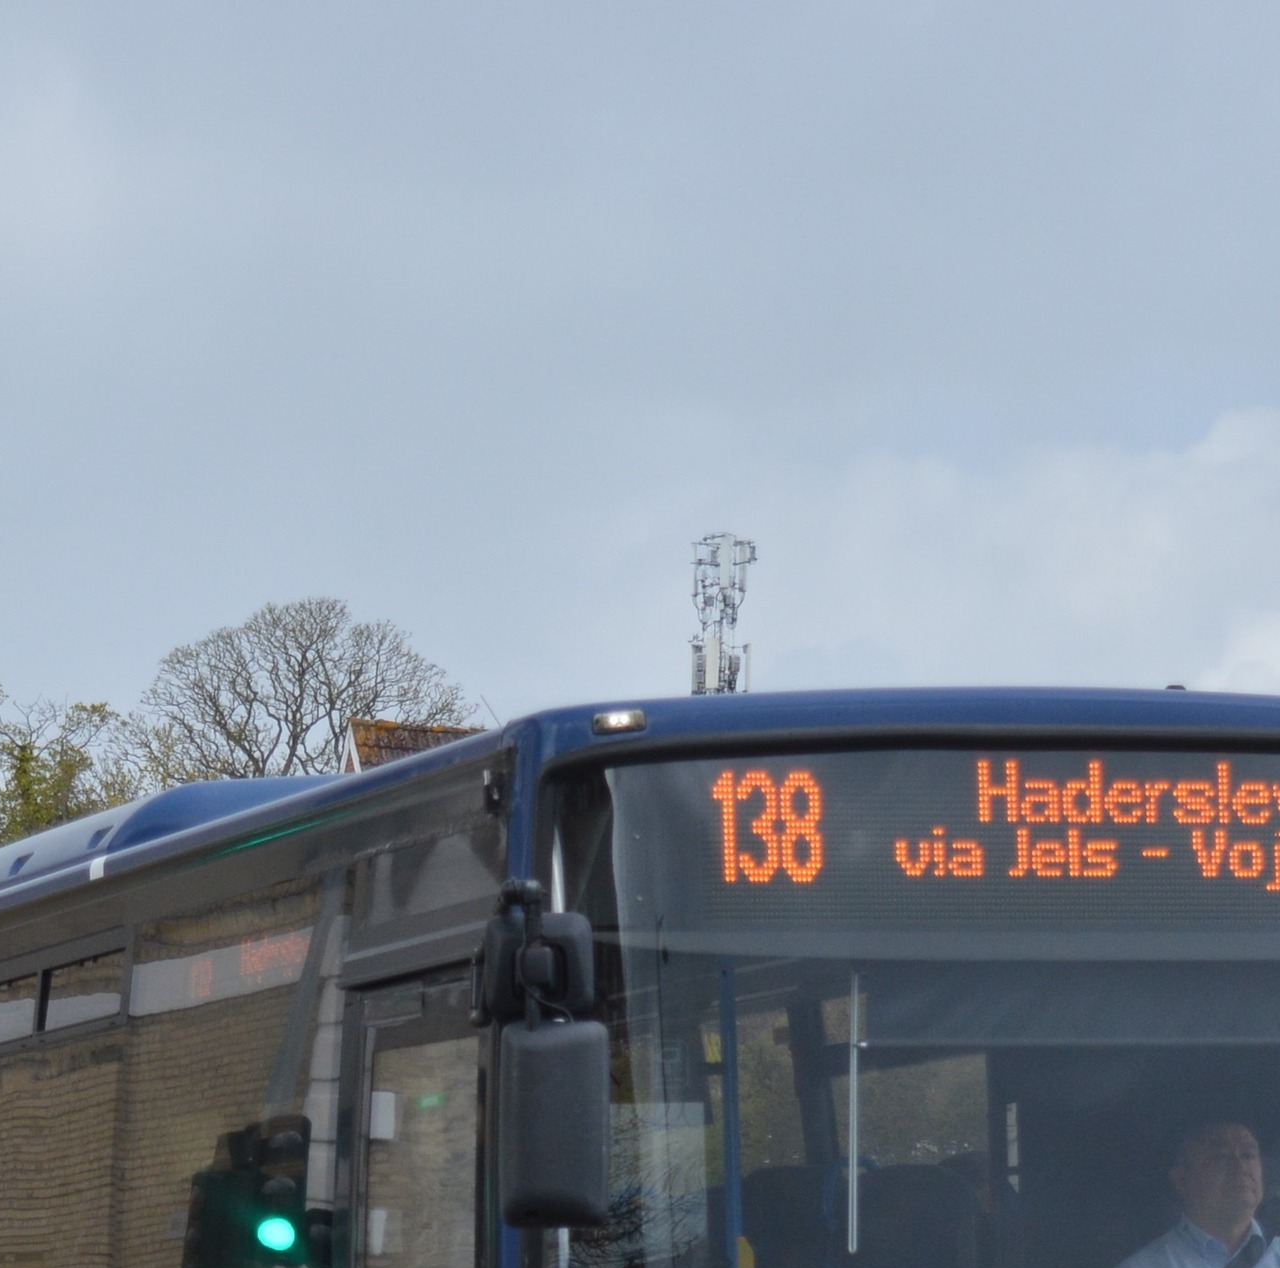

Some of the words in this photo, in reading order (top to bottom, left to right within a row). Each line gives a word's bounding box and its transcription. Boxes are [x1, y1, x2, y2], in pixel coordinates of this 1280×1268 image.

[713, 769, 823, 884] 138
[894, 826, 984, 878] via
[1008, 826, 1118, 878] Jels
